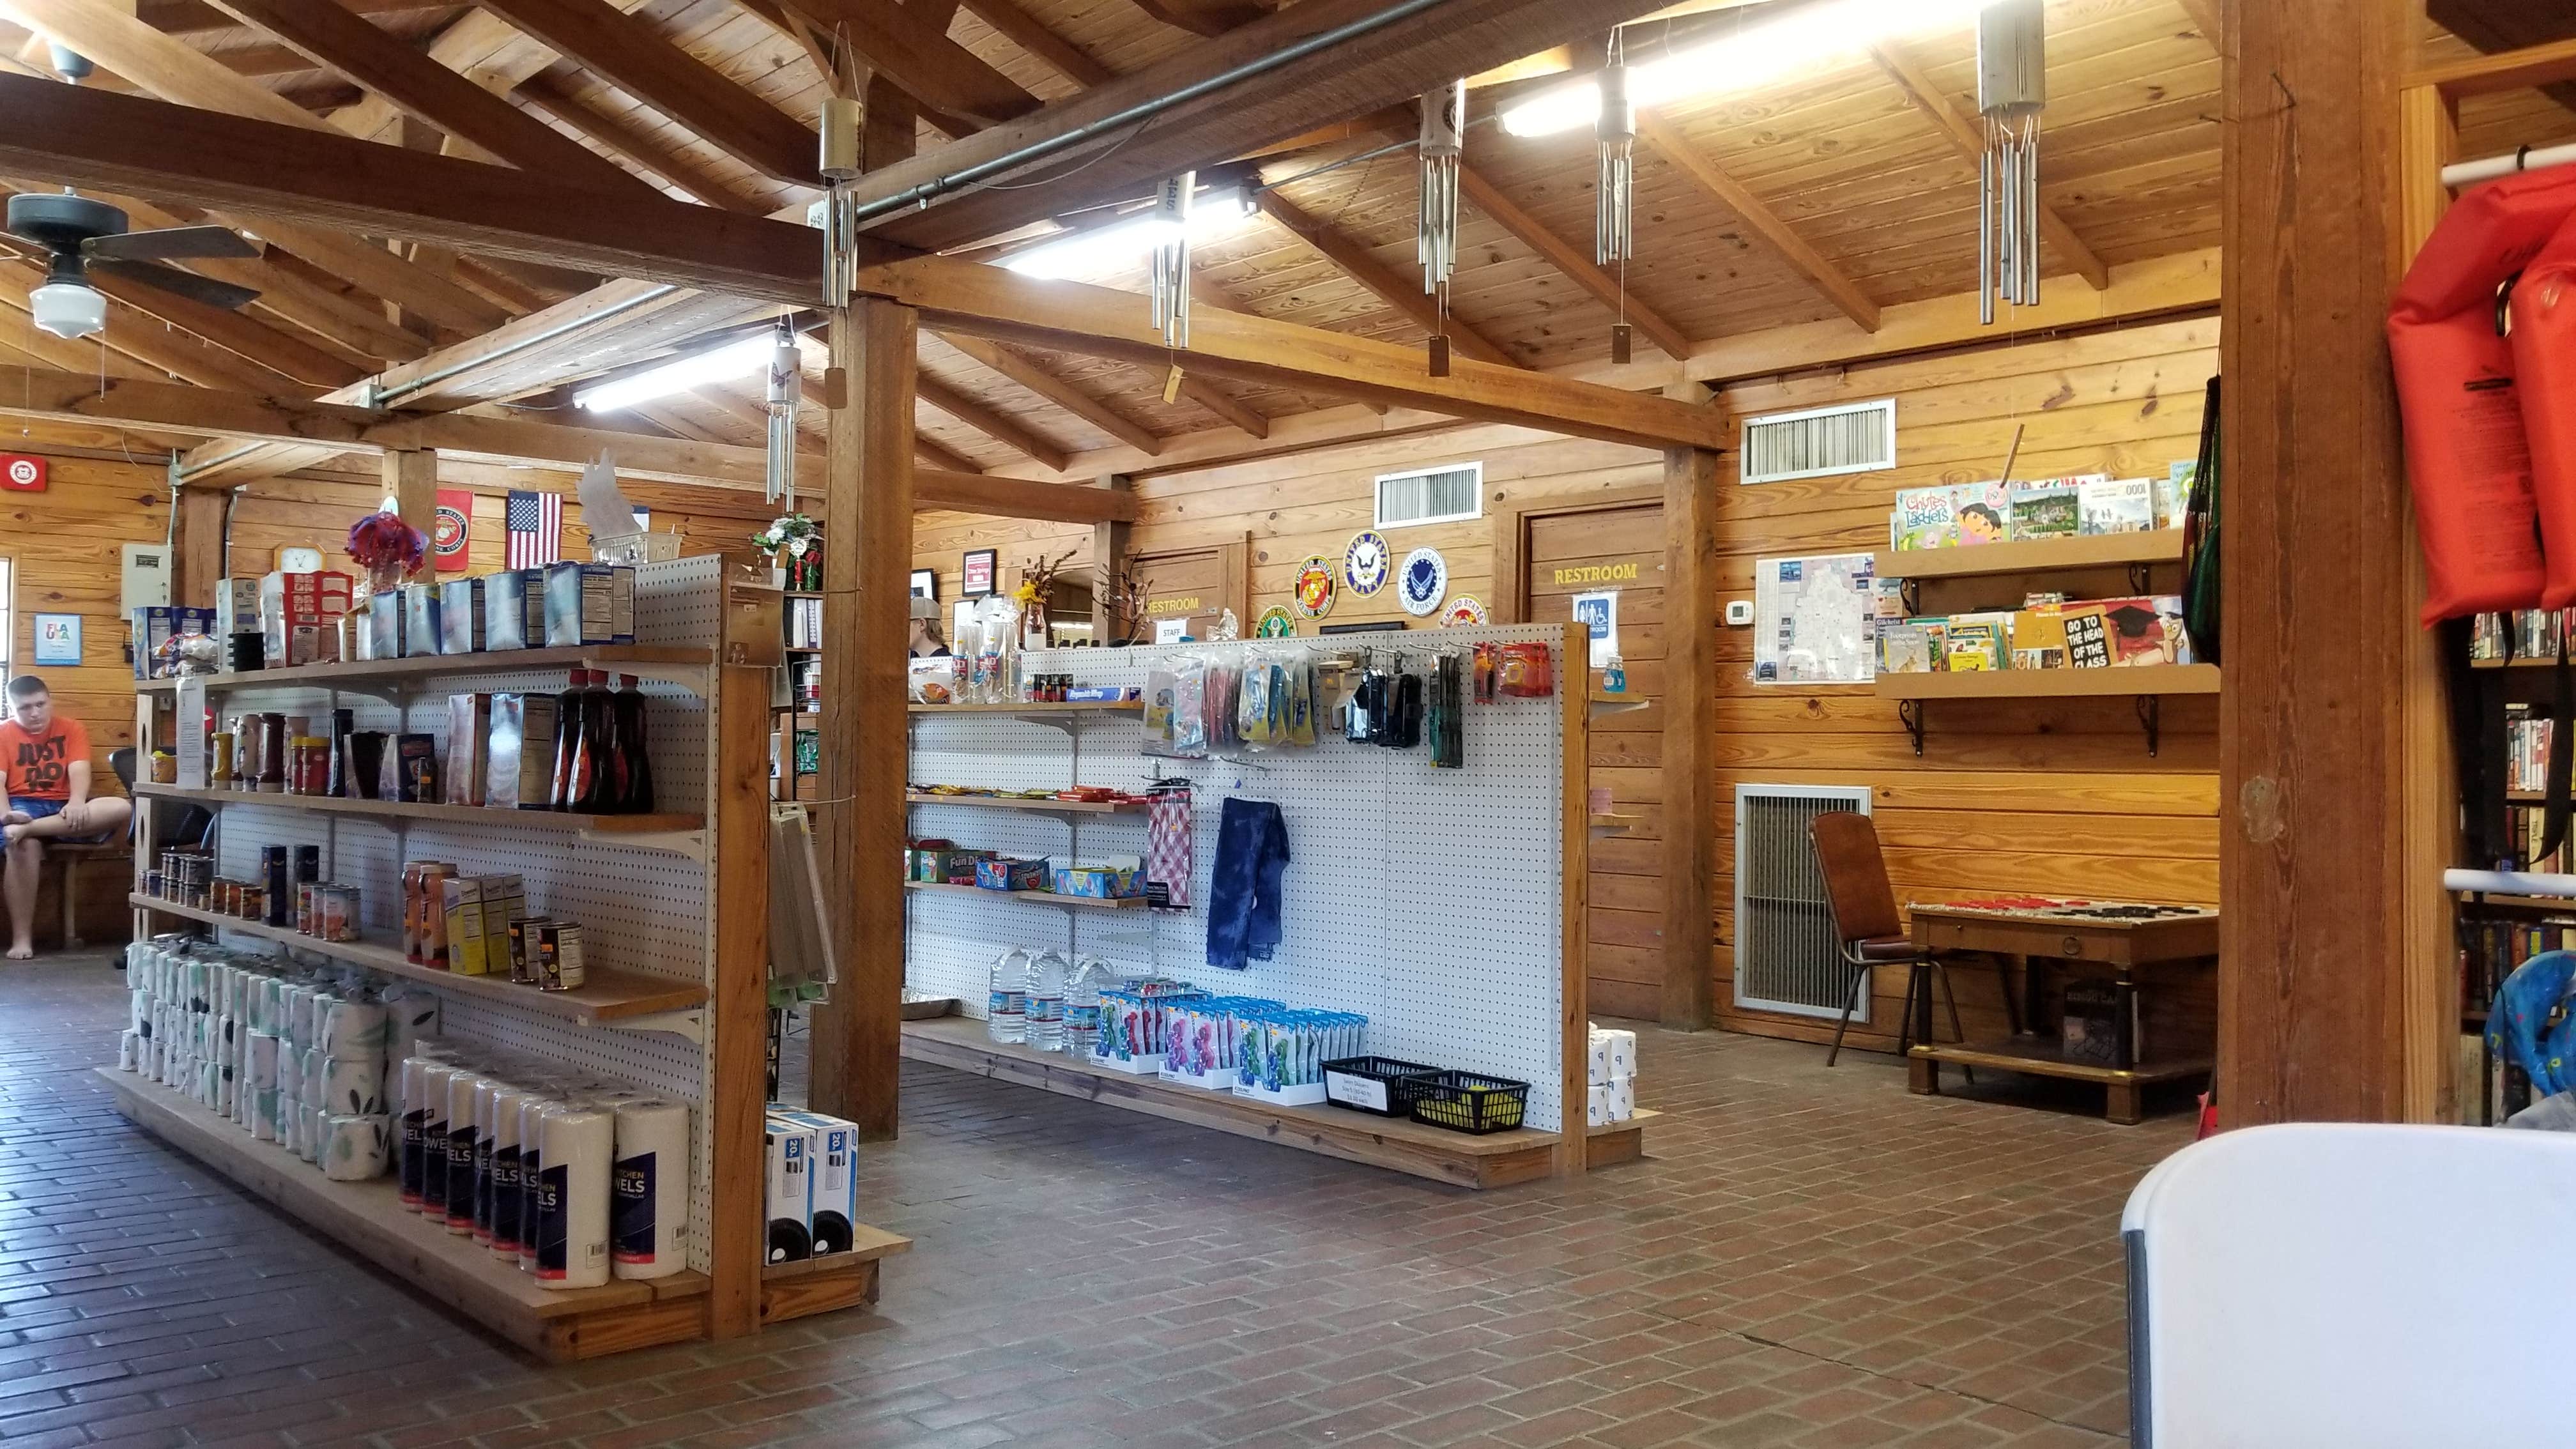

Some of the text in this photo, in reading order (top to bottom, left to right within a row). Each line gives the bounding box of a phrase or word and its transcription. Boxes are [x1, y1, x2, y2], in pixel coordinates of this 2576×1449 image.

[1906, 491, 1947, 510] Chutes
[1905, 509, 1949, 528] Ladders
[1346, 535, 1387, 572] UNITED STATES
[1402, 551, 1441, 575] UNITED STATES
[1296, 560, 1332, 583] UNITED STATES
[1554, 564, 1637, 585] RESTROOM
[1353, 581, 1379, 594] NAVY
[1147, 597, 1199, 613] RESTROOM
[1296, 595, 1331, 617] MARINE CORPS
[1404, 595, 1437, 610] AIR FORCE
[1464, 599, 1484, 621] STATES
[1259, 610, 1292, 627] UNITED STATES
[2067, 616, 2097, 633] GO TO
[2067, 627, 2104, 647] THE HEAD
[2073, 641, 2104, 659] OF THE
[2074, 655, 2107, 668] CLASS
[16, 735, 66, 767] JUST
[25, 762, 63, 782] DO
[950, 855, 967, 870] Fun
[967, 855, 977, 867] Di
